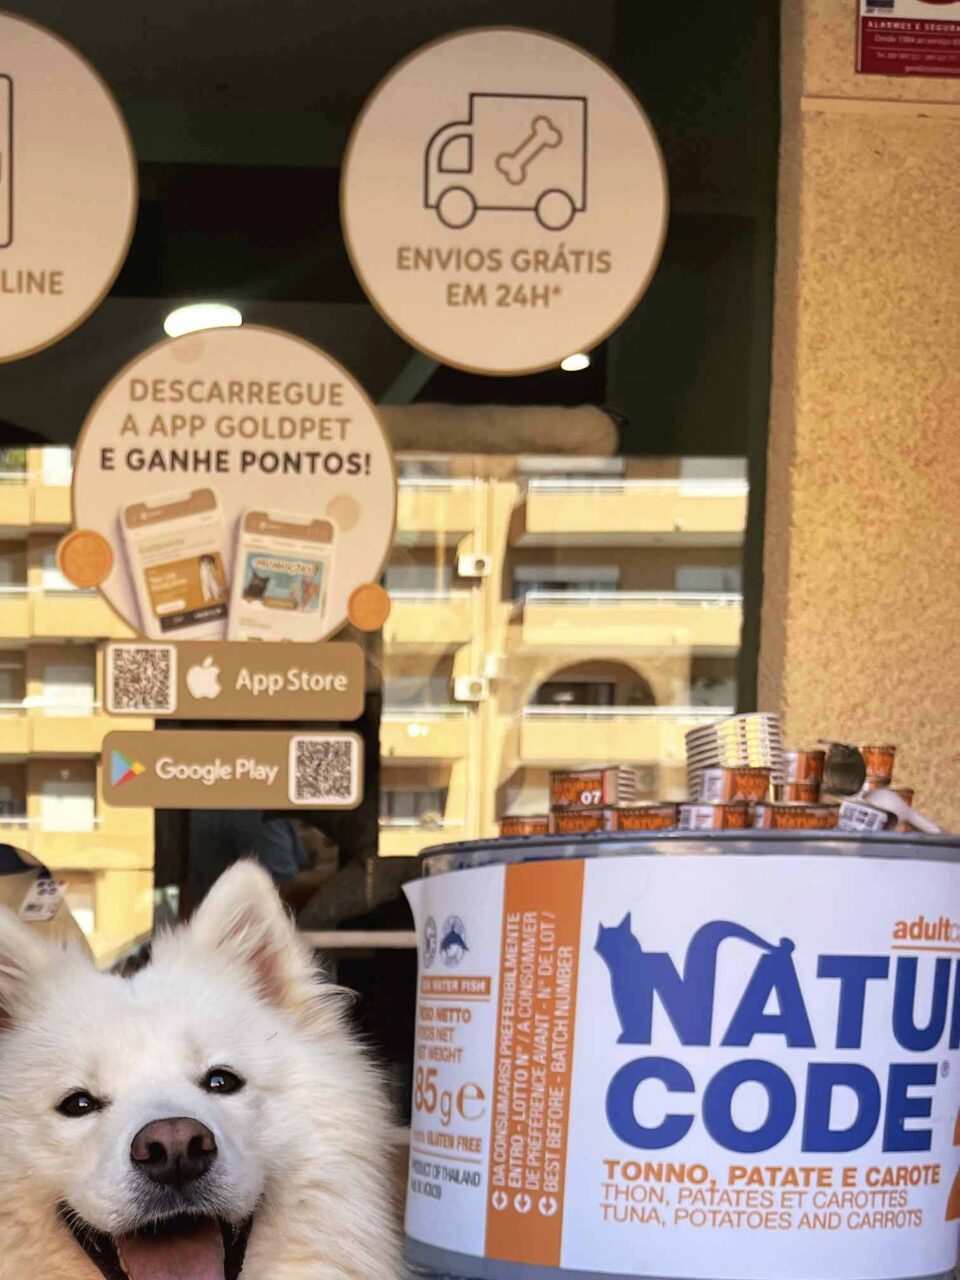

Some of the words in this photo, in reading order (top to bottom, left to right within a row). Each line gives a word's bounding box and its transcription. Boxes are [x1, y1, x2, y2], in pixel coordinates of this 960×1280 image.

[396, 246, 503, 273] ENVIOS
[511, 242, 613, 274] GRÁTIS
[446, 282, 487, 307] EM
[129, 378, 345, 407] DESCARREGUE
[119, 414, 141, 438] A
[149, 415, 207, 439] APP
[215, 415, 352, 441] GOLDPET
[100, 447, 115, 471] E
[126, 448, 231, 474] GANHE
[240, 450, 372, 476] PONTOS!
[235, 668, 283, 696] App
[286, 669, 349, 692] Store
[155, 757, 232, 786] Google
[235, 758, 279, 786] Play
[580, 790, 602, 805] 07
[540, 922, 556, 951] LOT
[517, 910, 538, 1019] CONSOMMER
[538, 955, 553, 977] DE
[461, 980, 486, 993] FISH
[554, 945, 574, 1018] NUMBER
[596, 912, 960, 1052] NATU
[436, 1007, 472, 1025] NETTO
[533, 1013, 550, 1065] AVANT
[551, 1018, 569, 1073] BATCH
[512, 1068, 529, 1122] LOTTO
[605, 1056, 938, 1154] CODE
[527, 1066, 547, 1168] PREFERENCE
[546, 1086, 565, 1149] BEFORE
[457, 1136, 482, 1154] FREE
[508, 1134, 525, 1188] ENTRO
[543, 1152, 560, 1193] BEST
[602, 1159, 717, 1190] TONNO,
[728, 1164, 834, 1188] PATATE
[841, 1166, 858, 1188] E
[865, 1163, 941, 1188] CAROTE
[525, 1168, 540, 1191] DE
[600, 1183, 670, 1206] THON,
[678, 1187, 775, 1209] PATATES
[780, 1190, 806, 1210] ET
[812, 1189, 908, 1210] CAROTTES
[600, 1204, 667, 1228] TUNA,
[673, 1206, 792, 1230] POTATOES
[797, 1209, 841, 1230] AND
[846, 1209, 923, 1230] CARROTS
